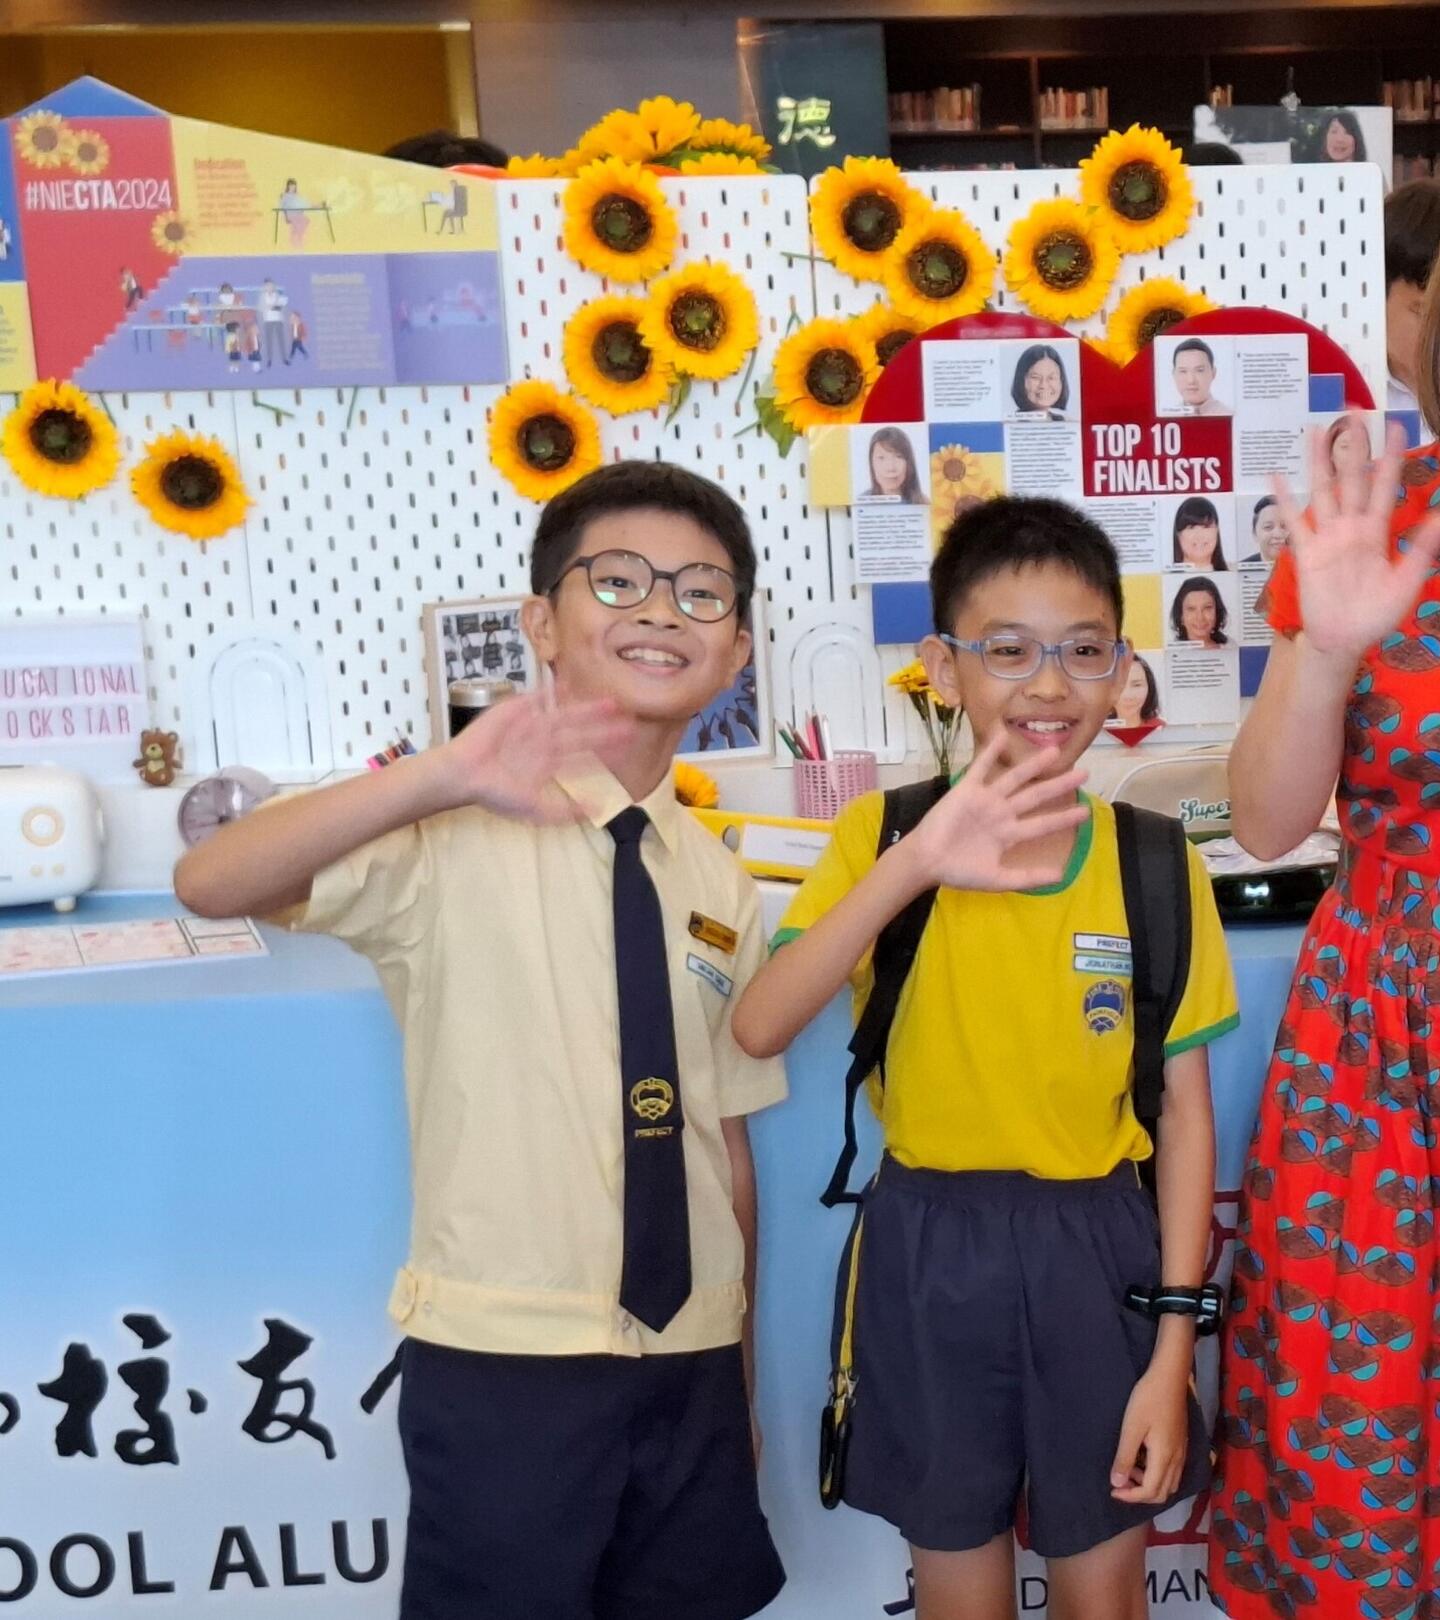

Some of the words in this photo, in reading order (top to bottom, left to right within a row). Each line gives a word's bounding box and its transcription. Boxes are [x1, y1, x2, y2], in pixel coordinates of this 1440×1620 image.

[26, 178, 172, 212] #NIECTA2024
[1091, 423, 1142, 457] TOP
[1150, 422, 1181, 456] 10
[1093, 457, 1222, 493] FINALISTS
[209, 1517, 390, 1592] ALU
